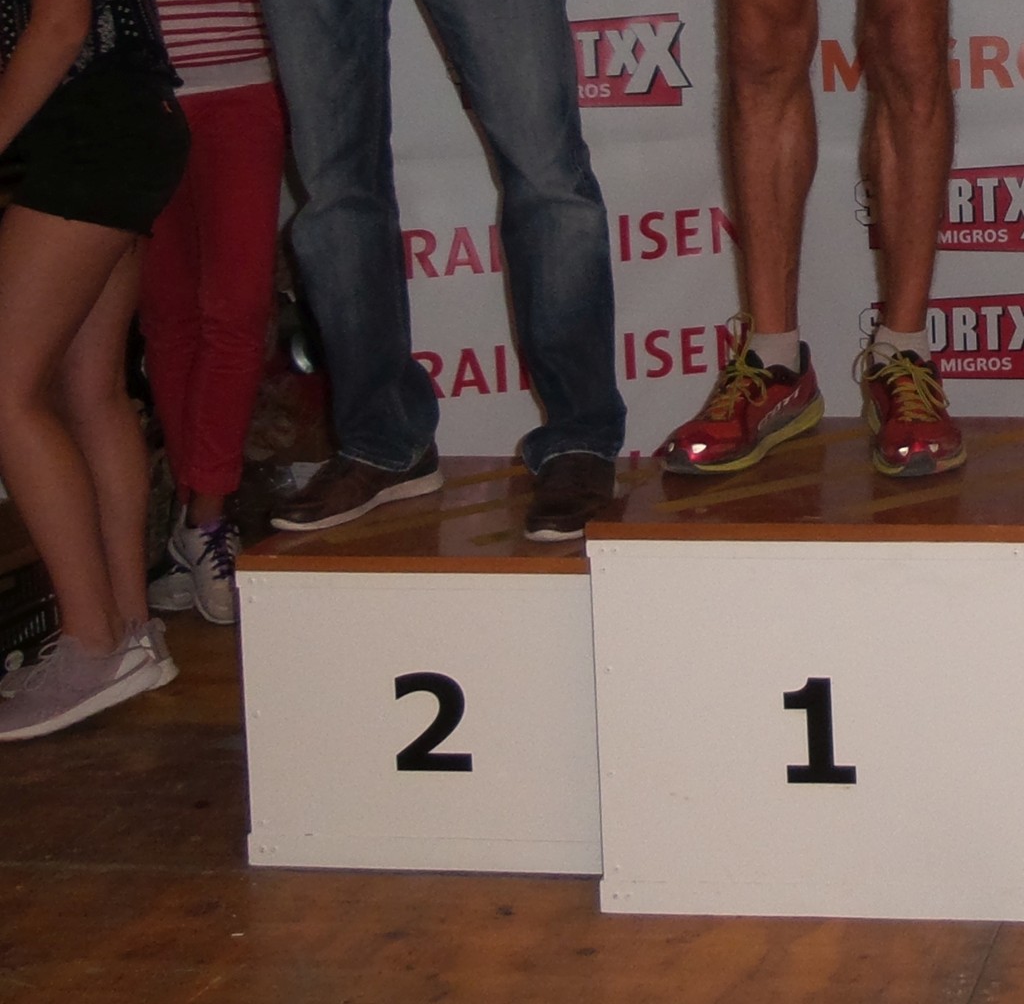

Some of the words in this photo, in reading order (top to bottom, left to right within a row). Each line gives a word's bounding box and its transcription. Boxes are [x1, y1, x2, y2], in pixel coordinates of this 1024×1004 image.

[401, 207, 744, 280] RAIISEN
[937, 228, 1009, 244] MIGROS
[410, 324, 750, 400] RAIISEN
[941, 357, 1012, 372] MIGROS
[394, 671, 474, 772] 2
[783, 677, 857, 784] 1
